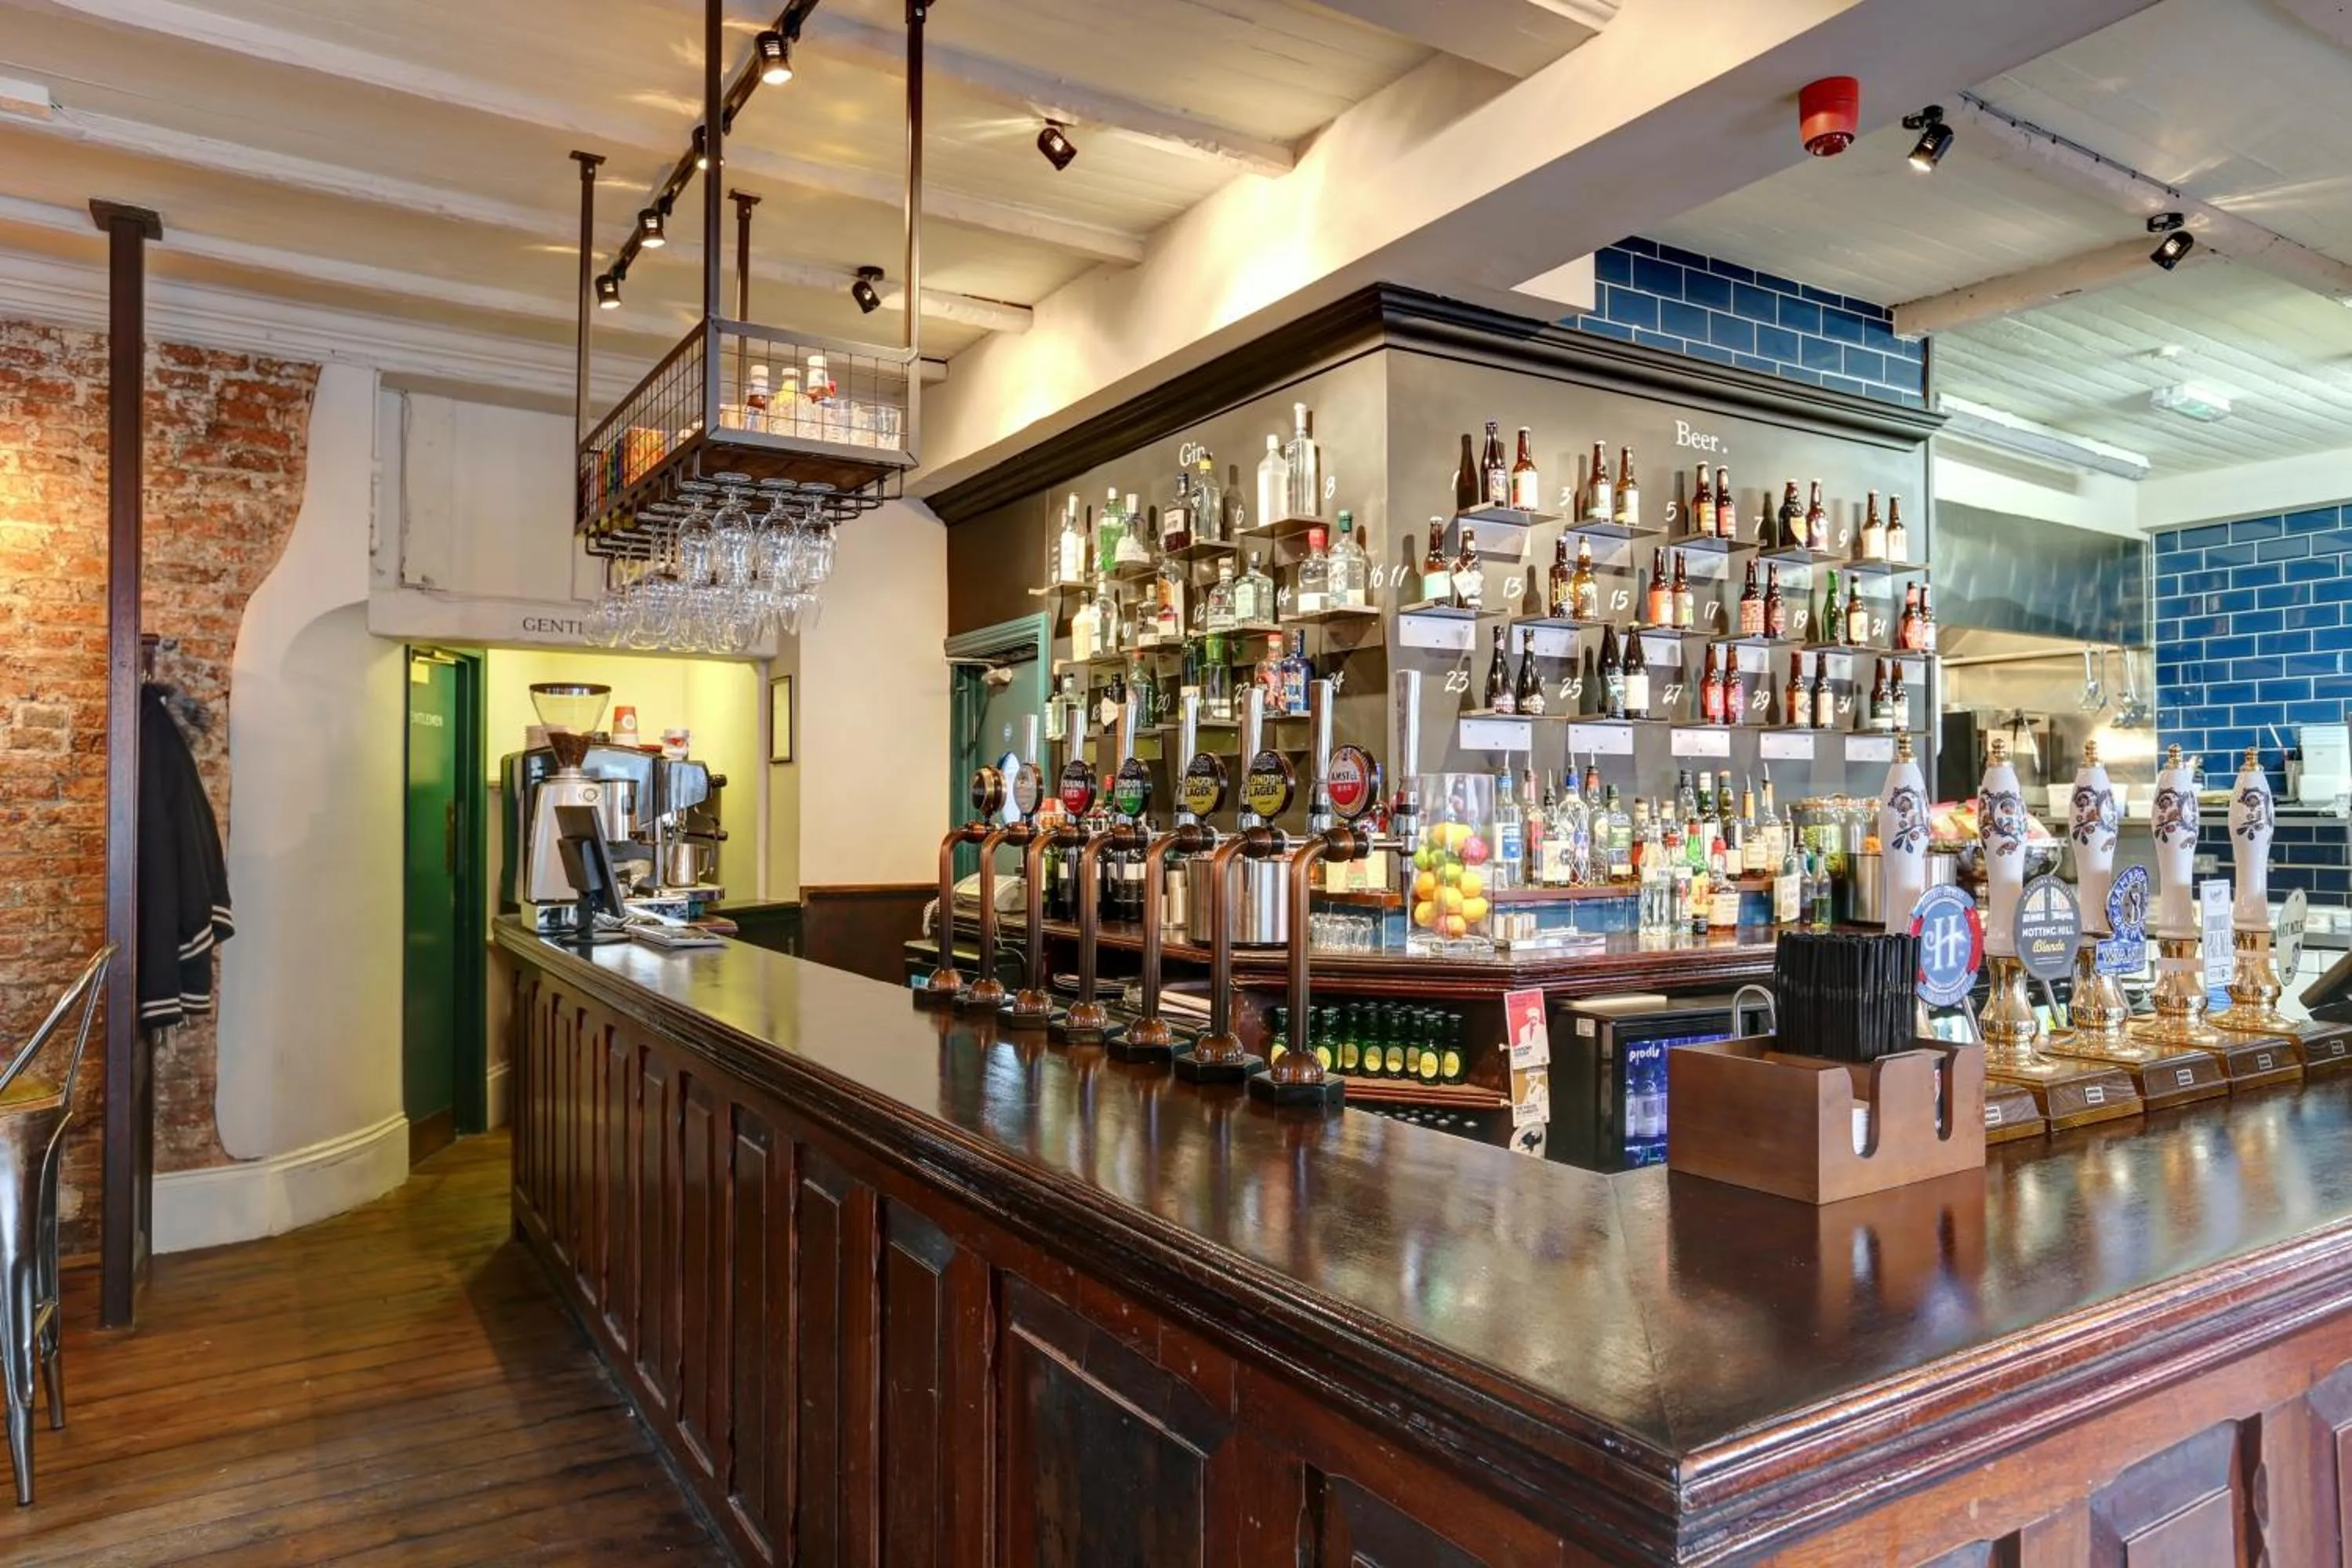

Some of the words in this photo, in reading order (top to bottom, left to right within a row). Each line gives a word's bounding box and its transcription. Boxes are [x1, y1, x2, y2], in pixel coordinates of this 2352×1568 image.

[1325, 476, 1335, 499] 8
[1559, 486, 1571, 506] 3
[1665, 501, 1678, 521] 5
[1755, 516, 1764, 535] 7
[1838, 529, 1848, 549] 9
[1370, 565, 1384, 588] 16
[1389, 565, 1409, 586] 11
[1503, 576, 1523, 599] 13
[1610, 590, 1628, 610] 15
[1704, 601, 1721, 620] 17
[1793, 609, 1809, 630] 19
[1872, 618, 1887, 637] 21
[1444, 670, 1469, 692] 23
[1559, 677, 1583, 699] 25
[1662, 684, 1683, 704] 27
[1751, 690, 1771, 710] 29
[1837, 696, 1853, 715] 31
[2022, 927, 2056, 937] NOTTING
[2058, 924, 2074, 935] HILL
